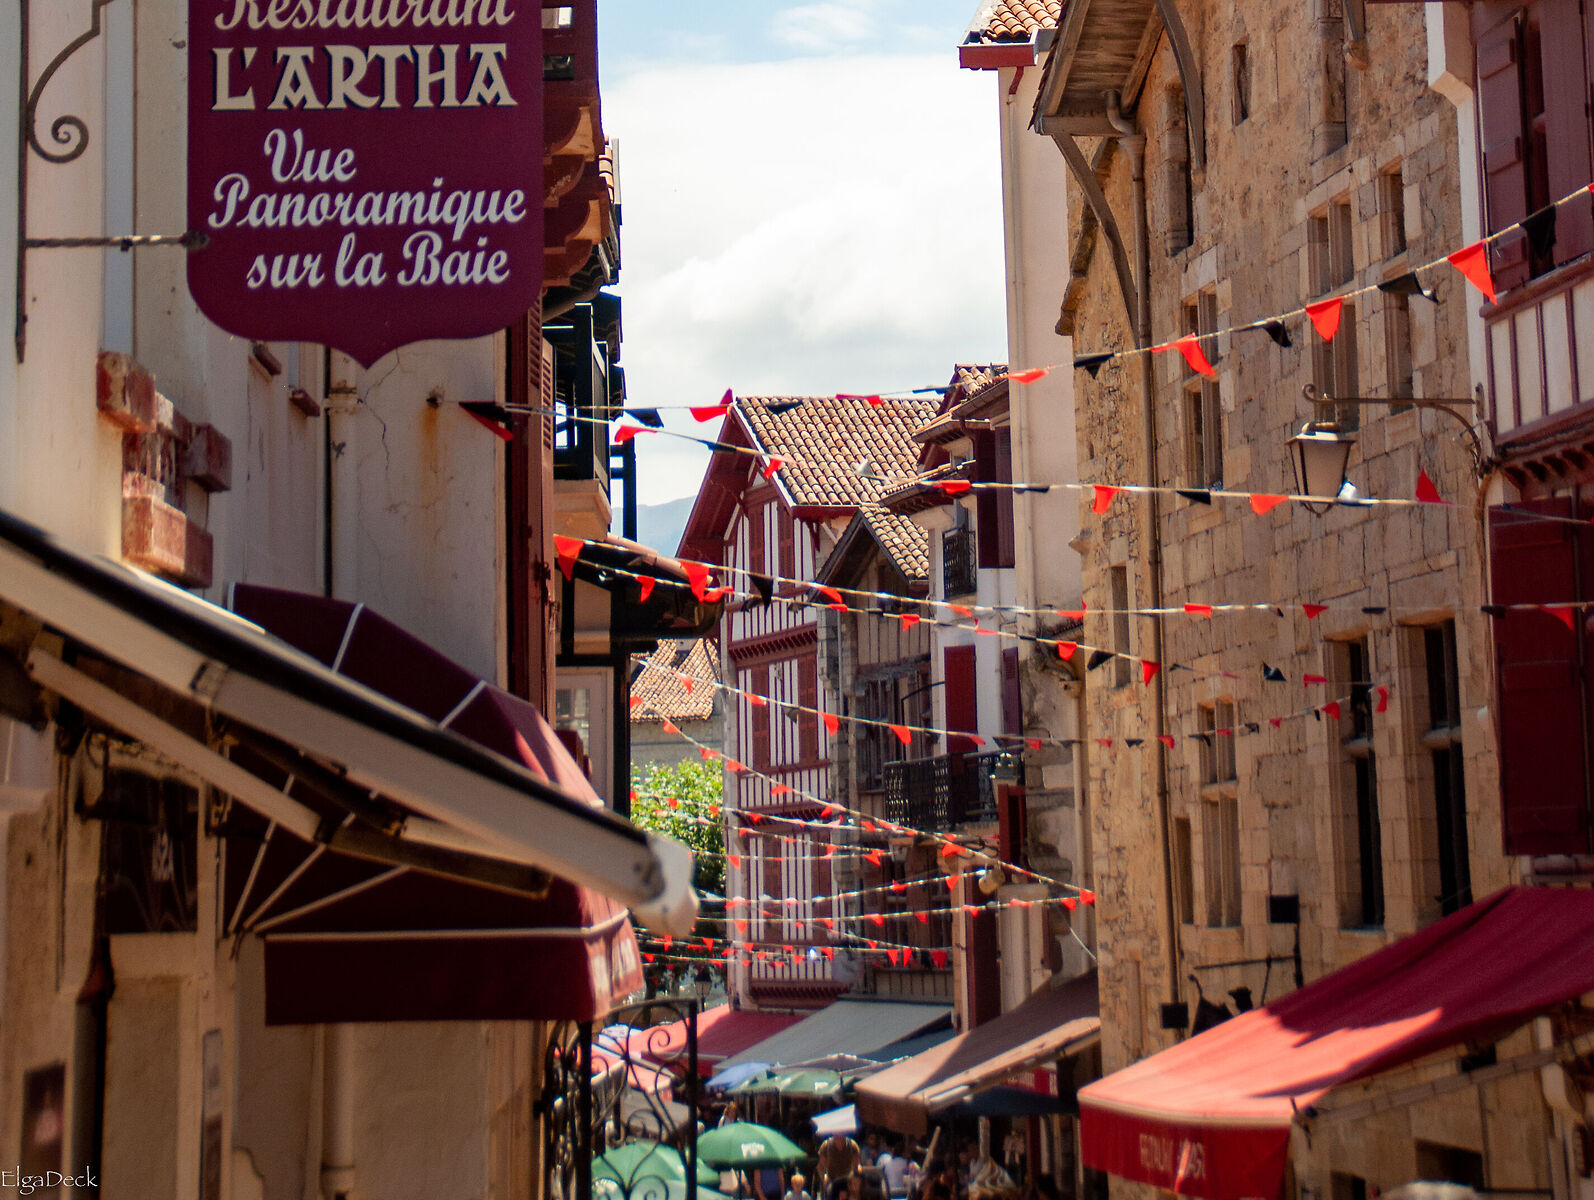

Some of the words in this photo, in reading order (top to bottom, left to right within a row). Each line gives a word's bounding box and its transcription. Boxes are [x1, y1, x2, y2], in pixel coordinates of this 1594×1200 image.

[209, 42, 519, 111] L'ARTHA
[263, 128, 357, 184] Vue
[207, 173, 527, 242] Panoramique
[246, 249, 325, 290] sur
[334, 231, 387, 288] la
[396, 230, 510, 287] Baie
